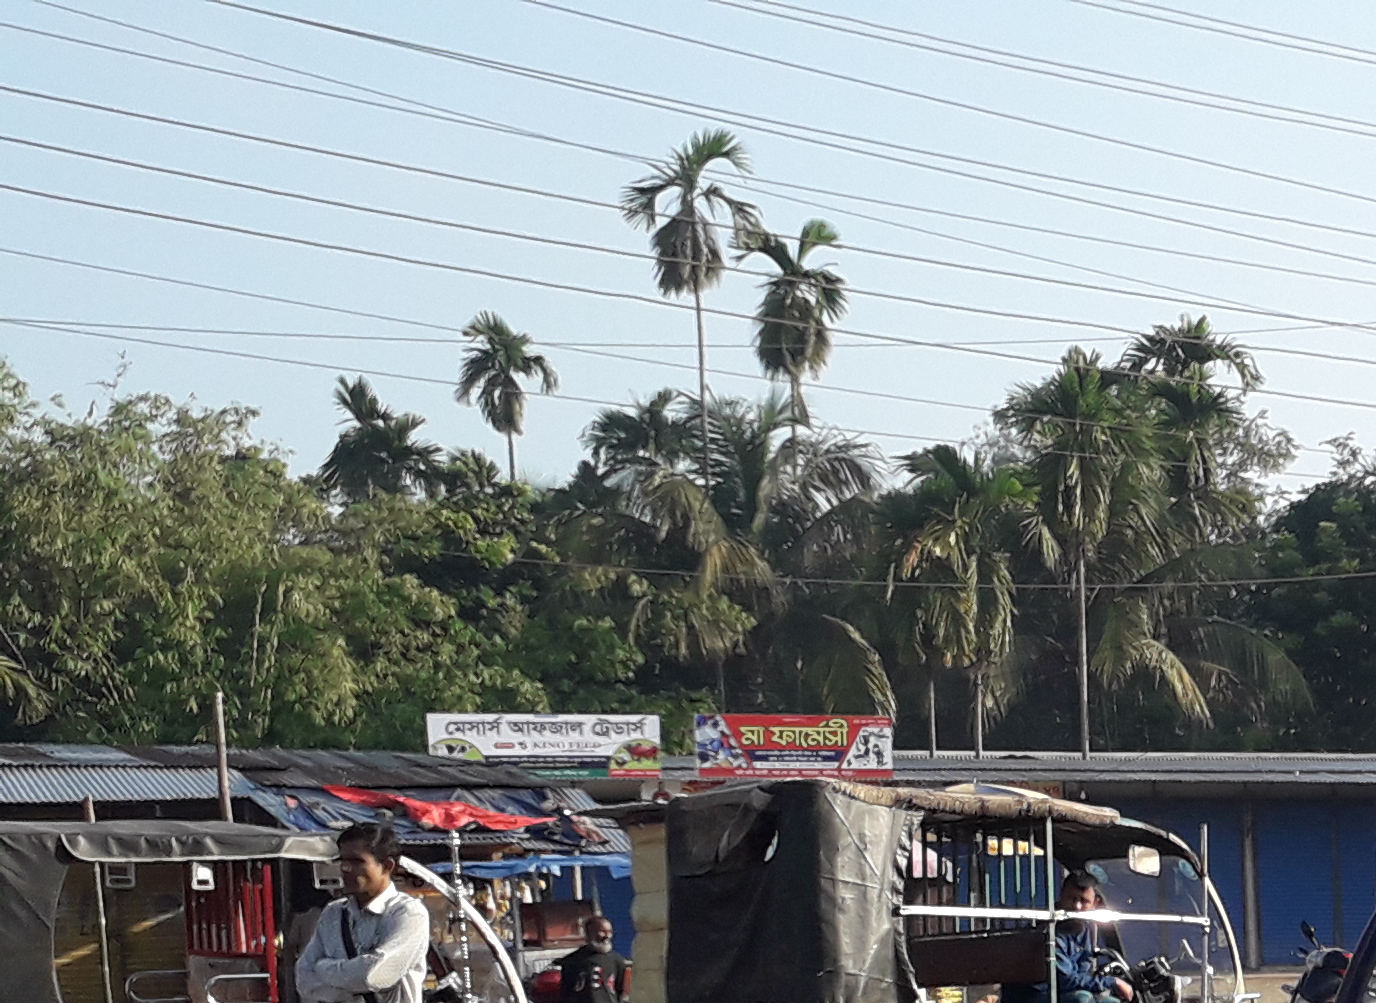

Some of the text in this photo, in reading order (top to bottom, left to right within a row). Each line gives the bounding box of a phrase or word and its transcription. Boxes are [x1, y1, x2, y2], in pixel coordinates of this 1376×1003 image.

[445, 717, 647, 740] মেসার্স আফজাল ট্রেডার্স
[738, 717, 851, 749] মা ফার্মেসী
